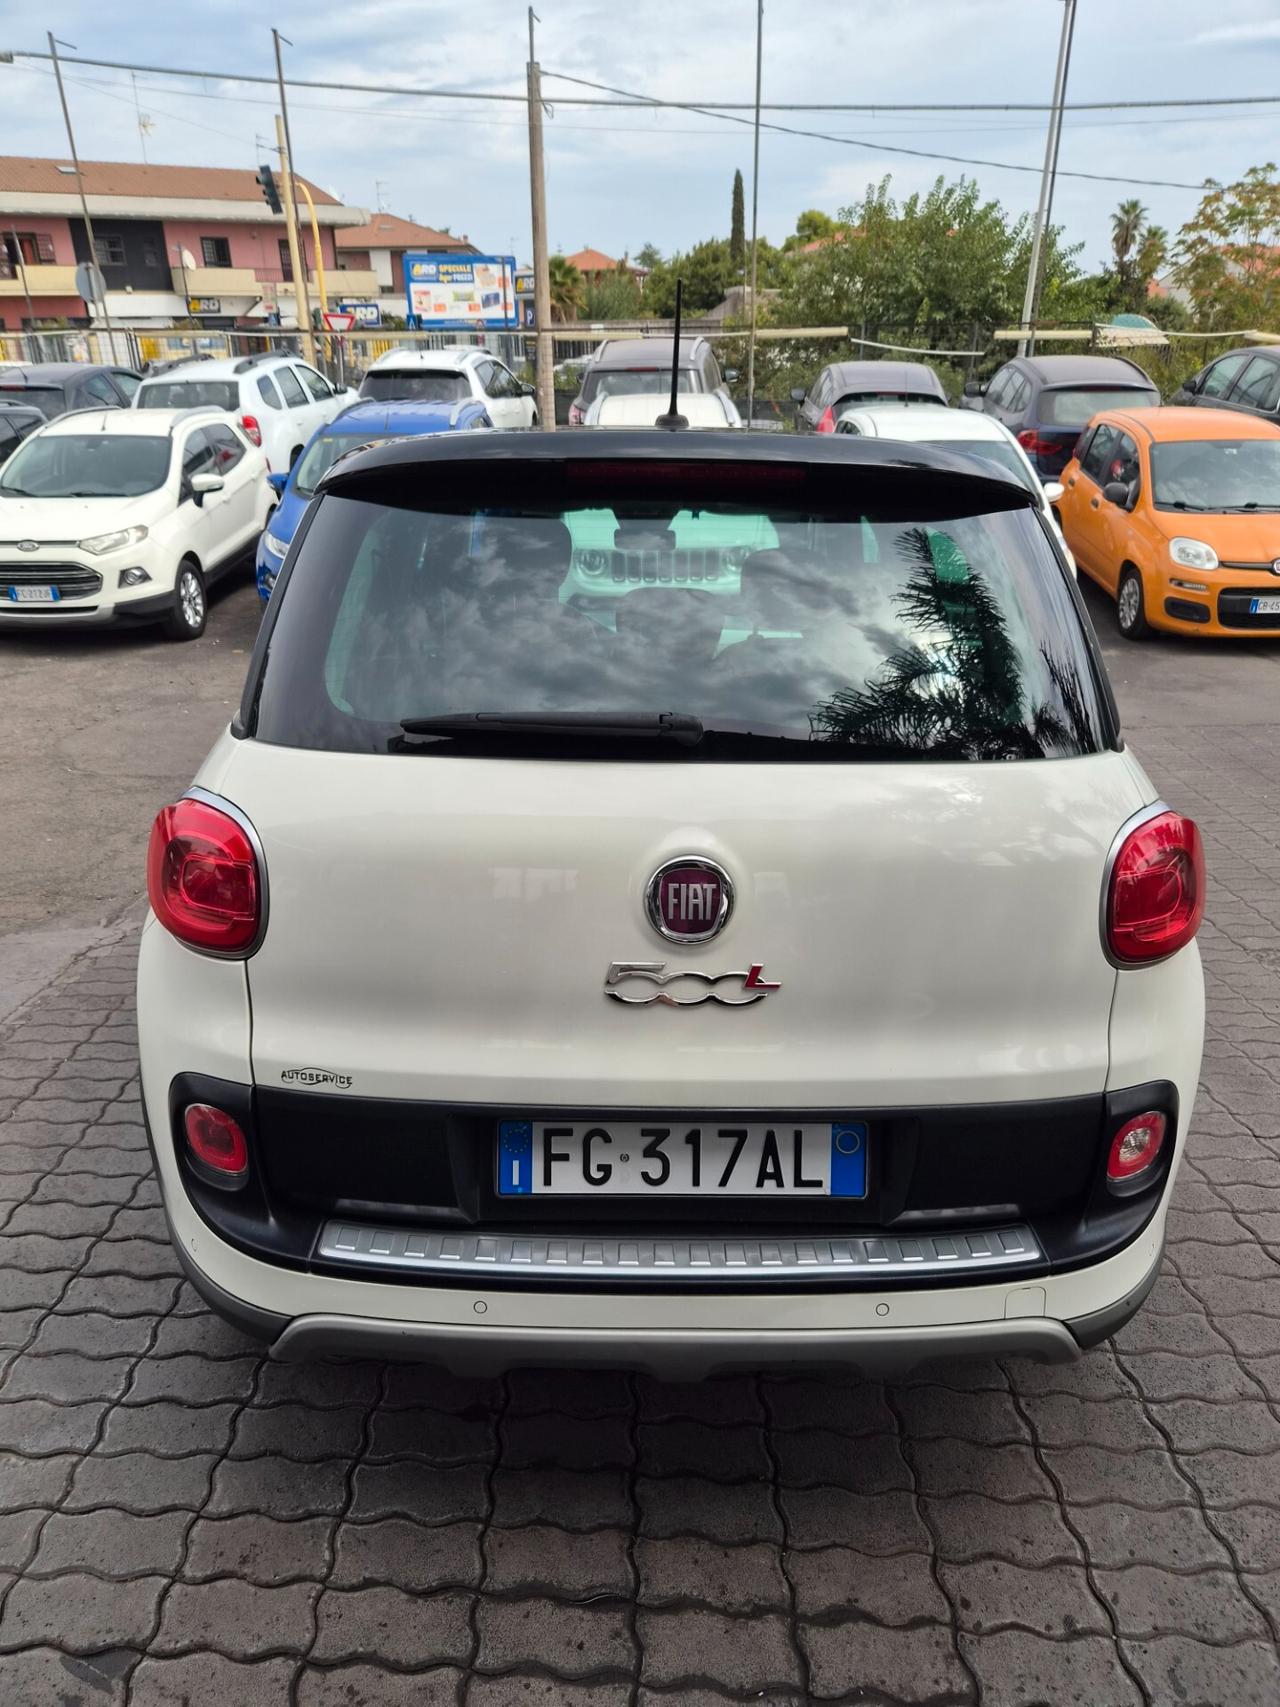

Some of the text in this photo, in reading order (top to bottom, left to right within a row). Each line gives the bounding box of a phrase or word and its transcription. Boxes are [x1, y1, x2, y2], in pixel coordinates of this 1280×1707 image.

[189, 299, 219, 313] ARD
[667, 882, 718, 921] FIAT
[603, 960, 784, 1009] 500L
[280, 1069, 353, 1086] AUTOSERVICE
[542, 1127, 614, 1189] FG
[640, 1127, 825, 1189] 317AL
